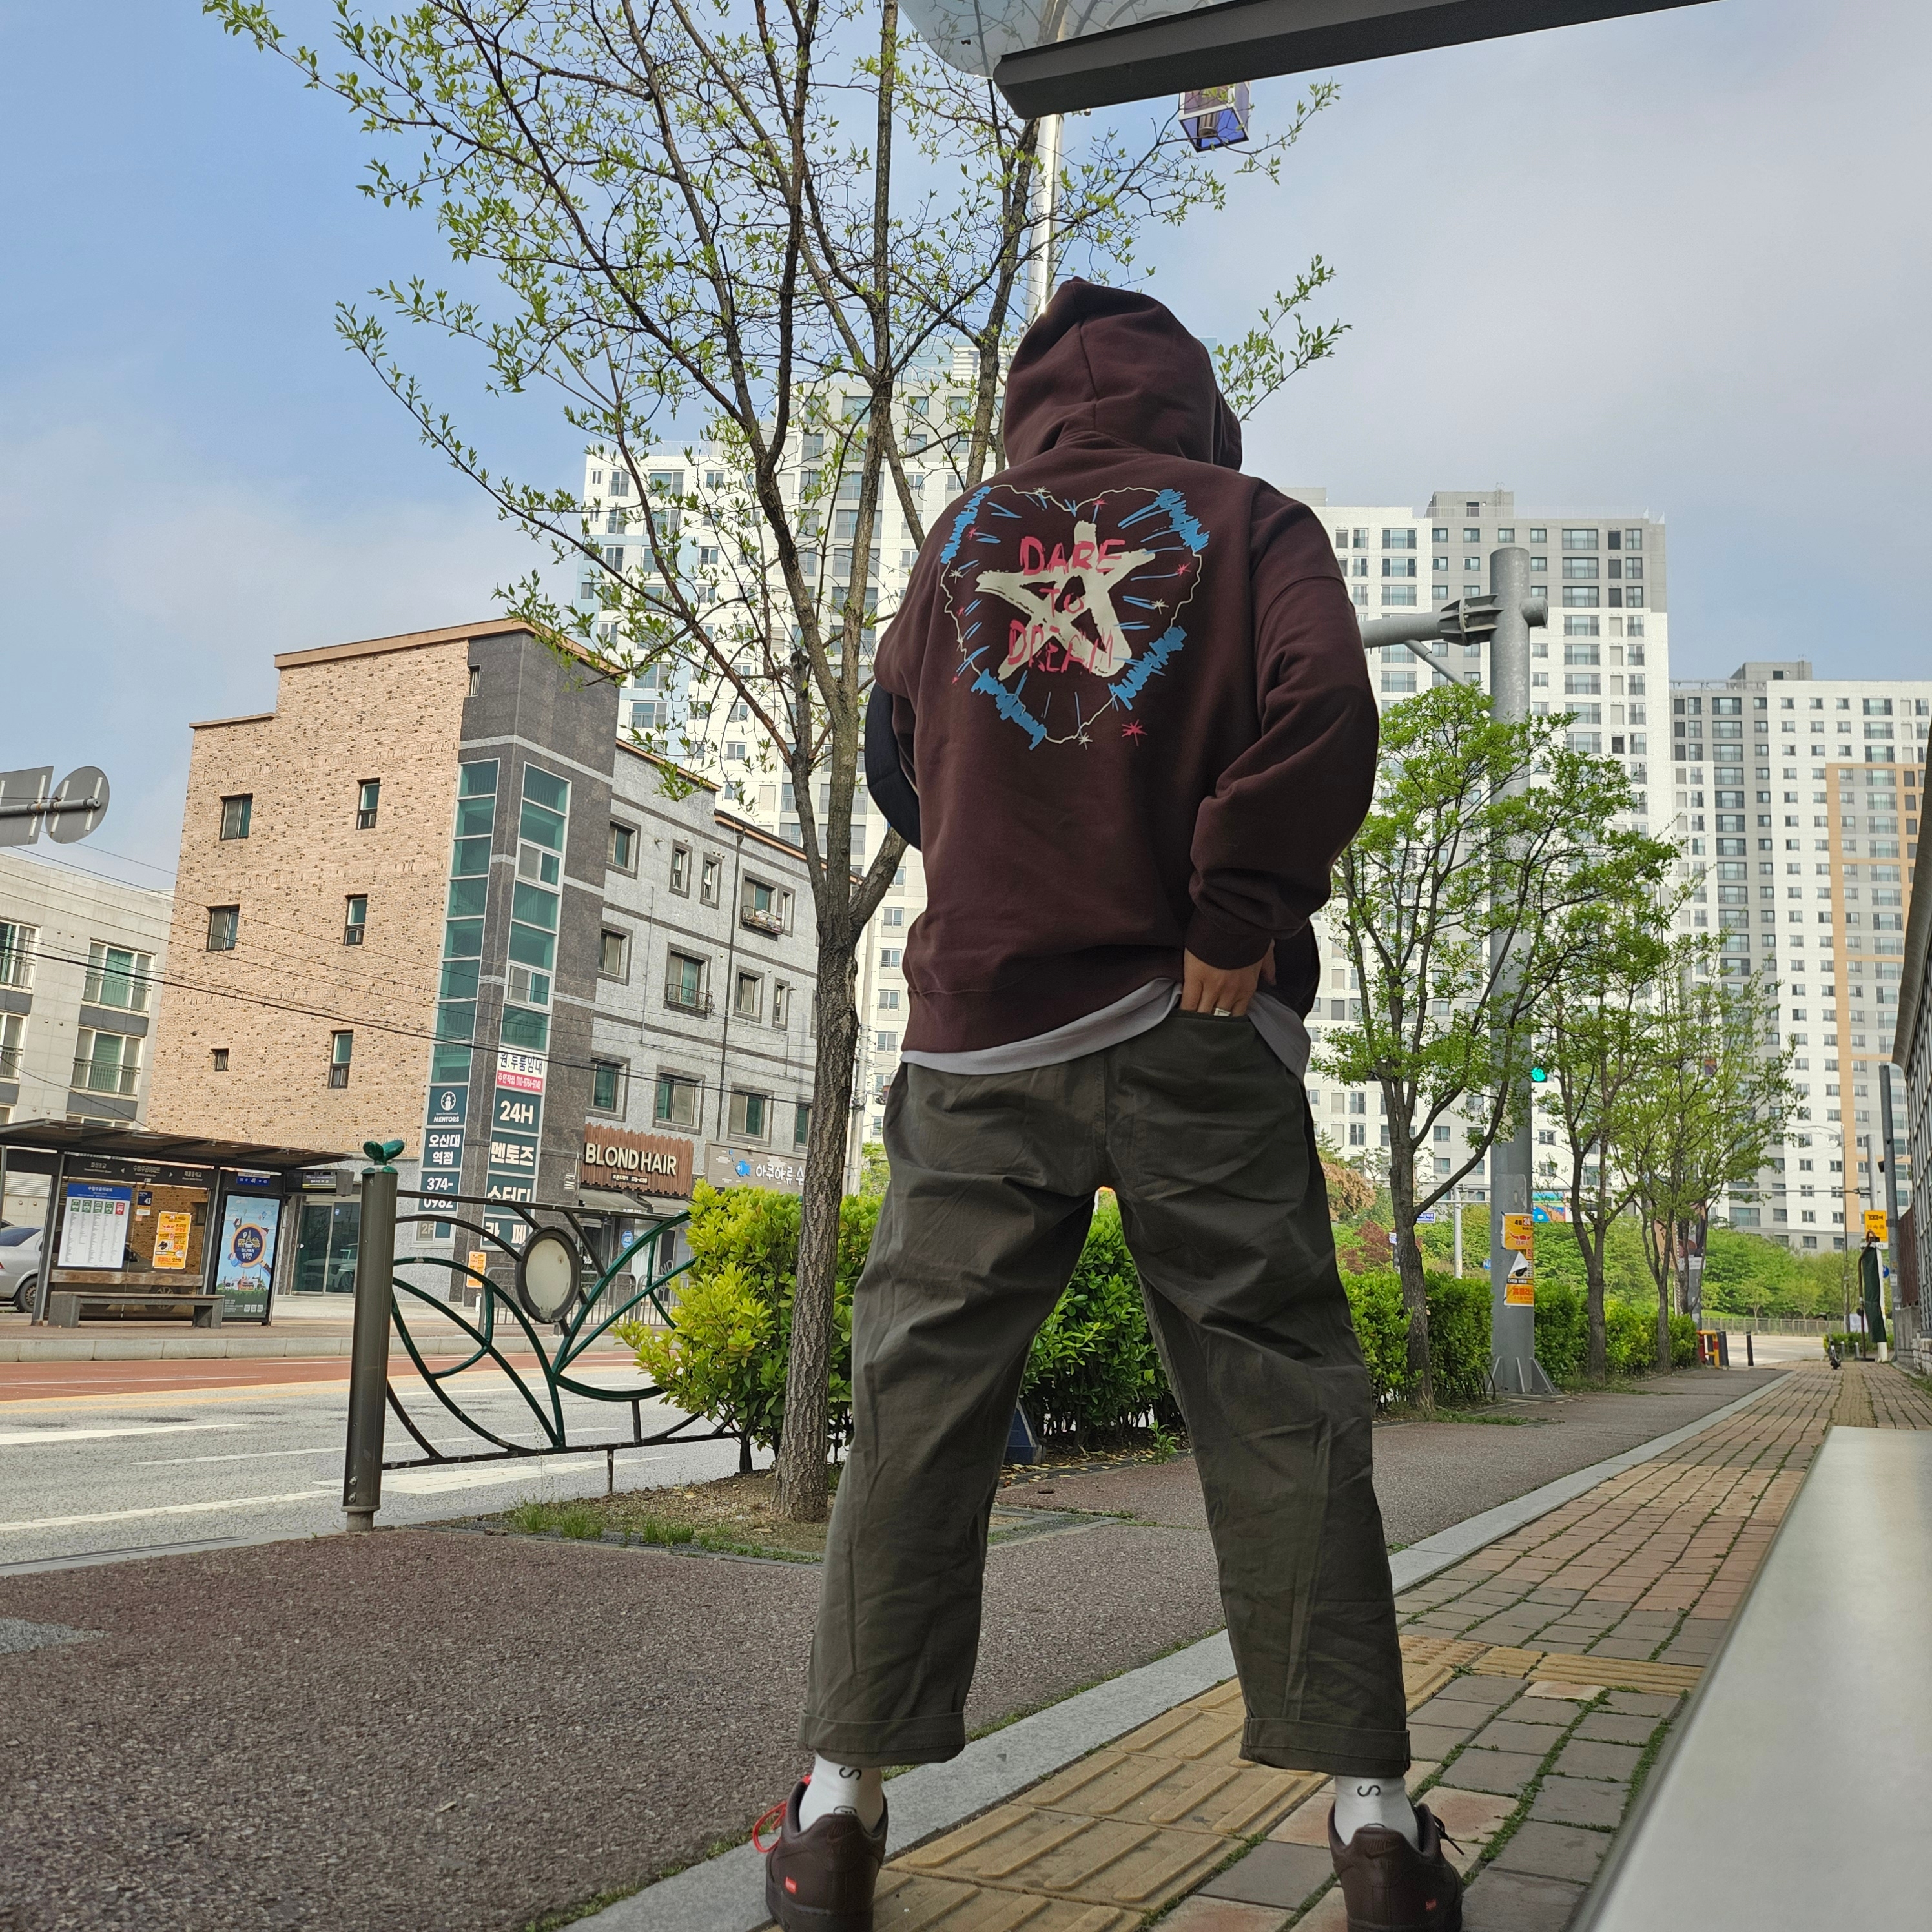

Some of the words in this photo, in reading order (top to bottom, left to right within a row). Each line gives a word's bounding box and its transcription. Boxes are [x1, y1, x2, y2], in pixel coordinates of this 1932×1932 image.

[1020, 536, 1125, 576] DARE
[1039, 588, 1084, 618] TO
[1007, 619, 1113, 674] DREAM
[500, 1100, 534, 1125] 24H
[429, 1134, 460, 1147] 오산대
[433, 1151, 453, 1165] 역점
[491, 1142, 534, 1167] 멘토즈
[585, 1142, 639, 1170] BLOND
[640, 1151, 677, 1175] HAIR
[427, 1178, 453, 1191] 374-
[421, 1222, 433, 1235] 2F
